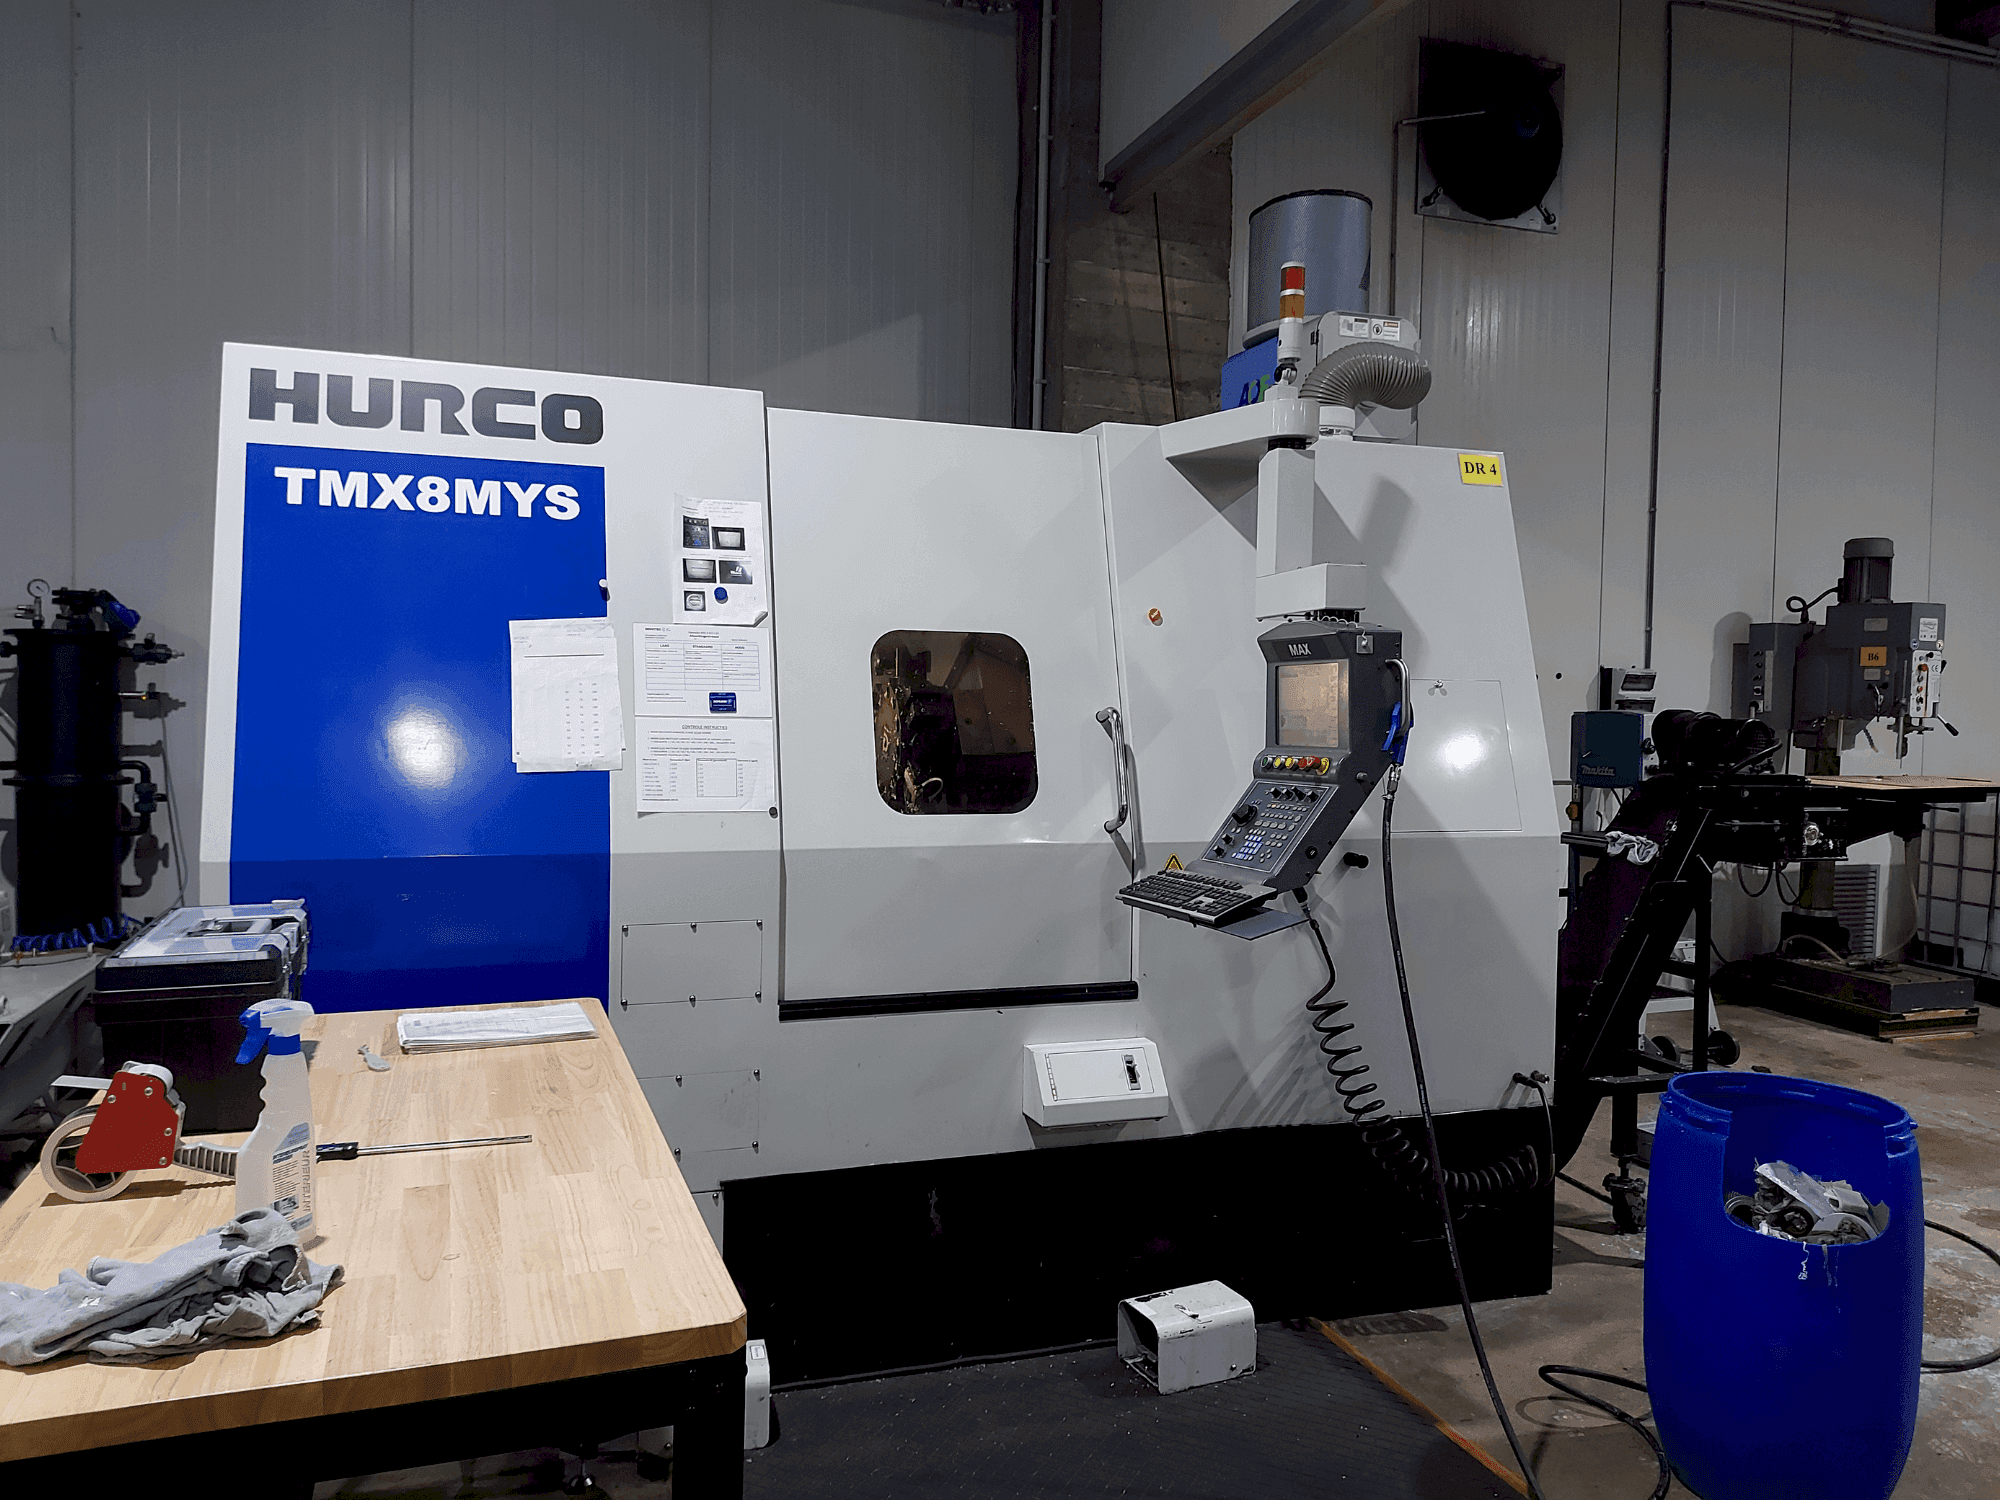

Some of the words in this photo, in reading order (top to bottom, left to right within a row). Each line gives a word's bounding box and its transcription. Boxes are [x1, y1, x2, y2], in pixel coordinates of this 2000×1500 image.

[249, 368, 604, 445] HURCO
[1464, 460, 1486, 475] DR
[1489, 463, 1497, 476] 4
[274, 466, 580, 521] TMX8MYS
[1288, 643, 1311, 657] MAX
[1868, 653, 1879, 661] B6
[302, 1150, 311, 1212] INTERIEUR
